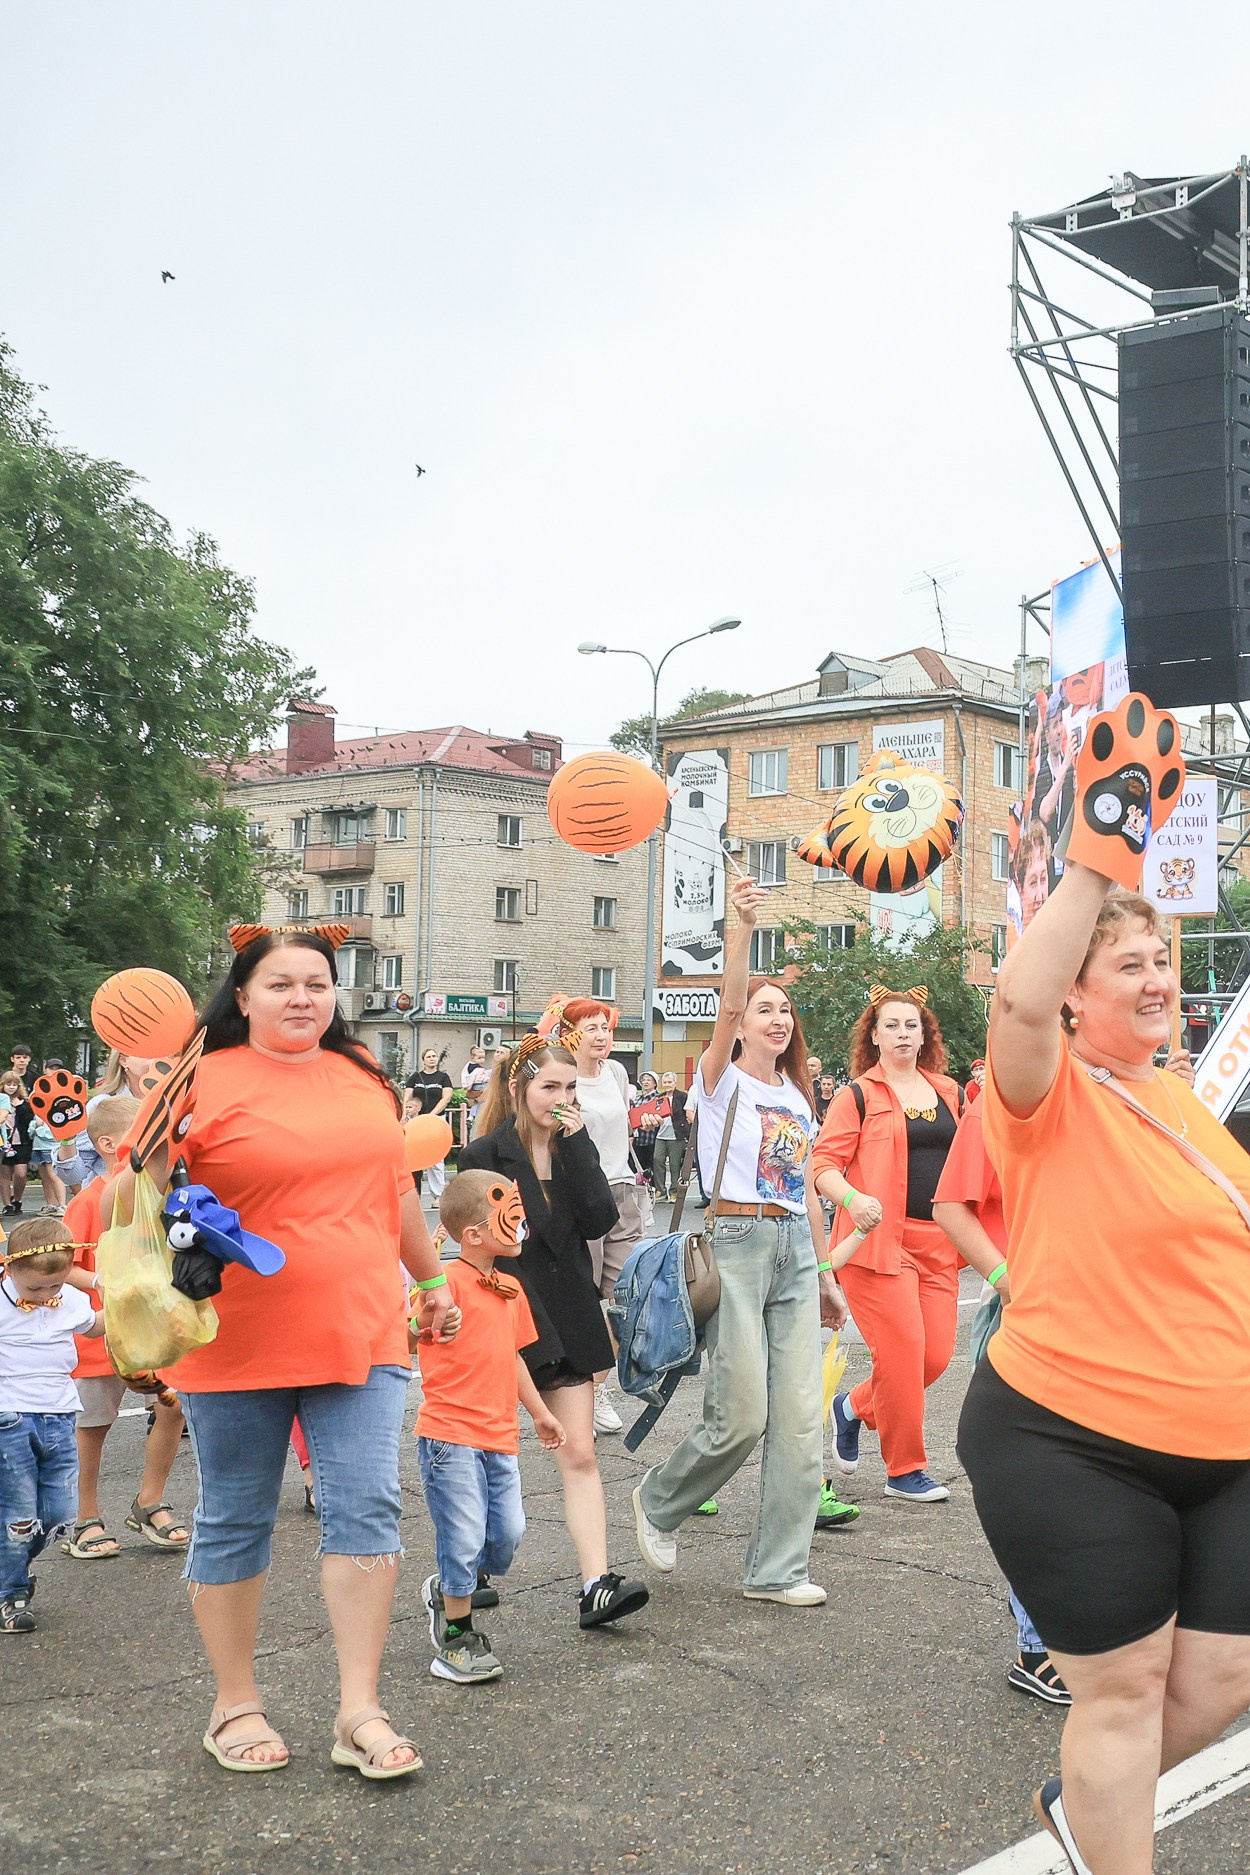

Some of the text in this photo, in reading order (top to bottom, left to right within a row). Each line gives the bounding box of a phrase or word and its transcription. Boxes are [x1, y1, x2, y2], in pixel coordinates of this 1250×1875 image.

[879, 732, 933, 748] МЕНЬШЕ
[897, 746, 937, 760] АХАРА
[681, 778, 718, 787] КОМБИНАТ
[1157, 834, 1181, 846] САД
[1183, 834, 1195, 846] №
[1197, 834, 1203, 846] 9
[683, 897, 709, 906] МОЛОКО
[665, 929, 693, 941] МОЛОКО
[448, 1002, 486, 1013] БАЛТИКА
[665, 993, 717, 1017] ЗАБОТА
